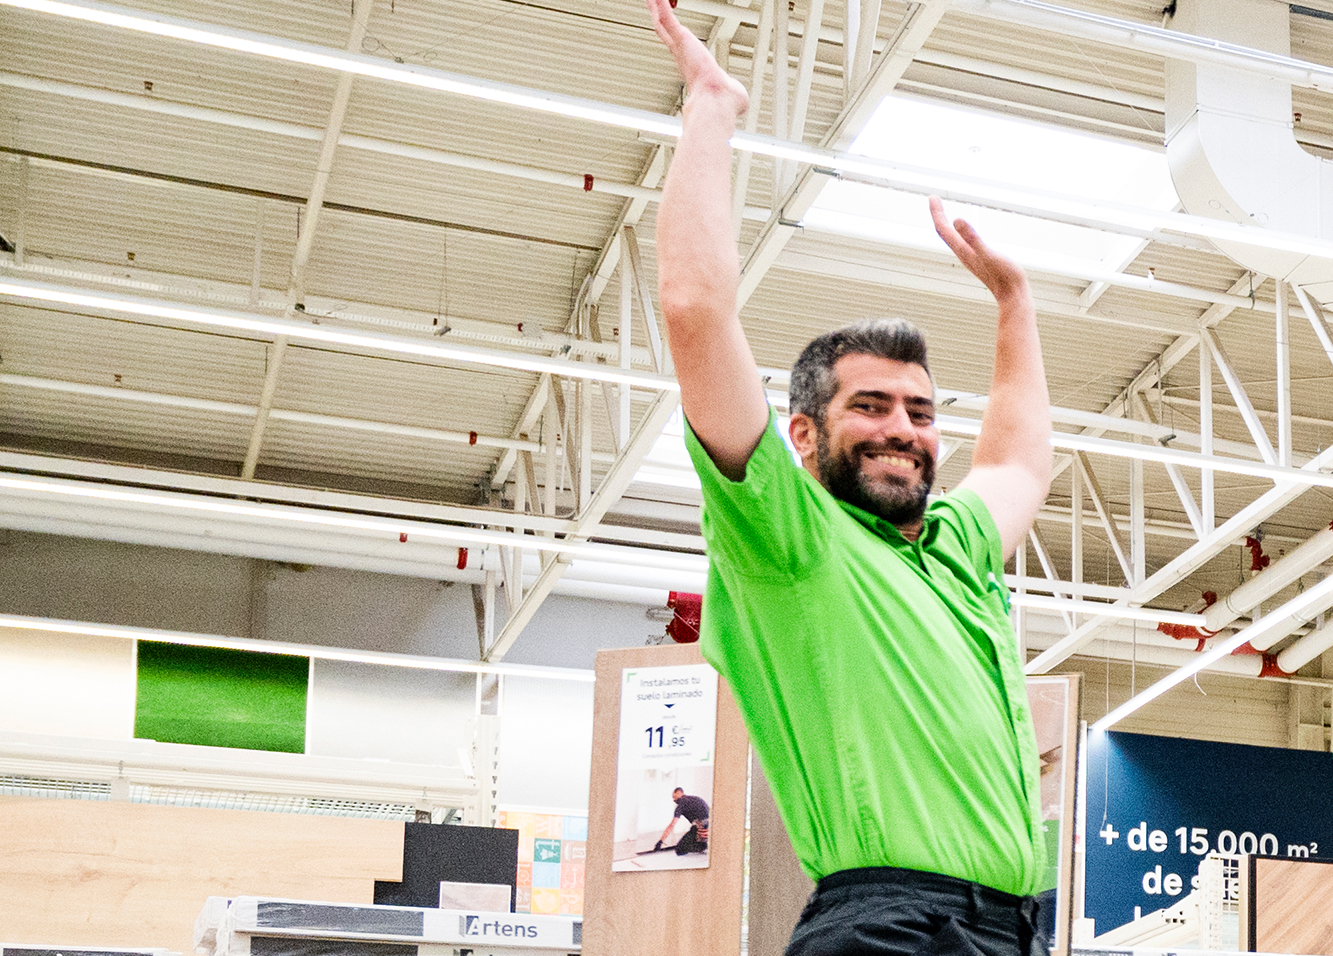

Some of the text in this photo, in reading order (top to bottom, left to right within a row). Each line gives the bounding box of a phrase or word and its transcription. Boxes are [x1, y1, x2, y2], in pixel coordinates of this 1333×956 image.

[640, 677, 689, 687] Instalamos
[637, 690, 703, 701] suelo laminado
[645, 726, 664, 748] 11
[1128, 821, 1168, 852] de
[1143, 865, 1183, 895] de
[466, 915, 538, 938] Artens
